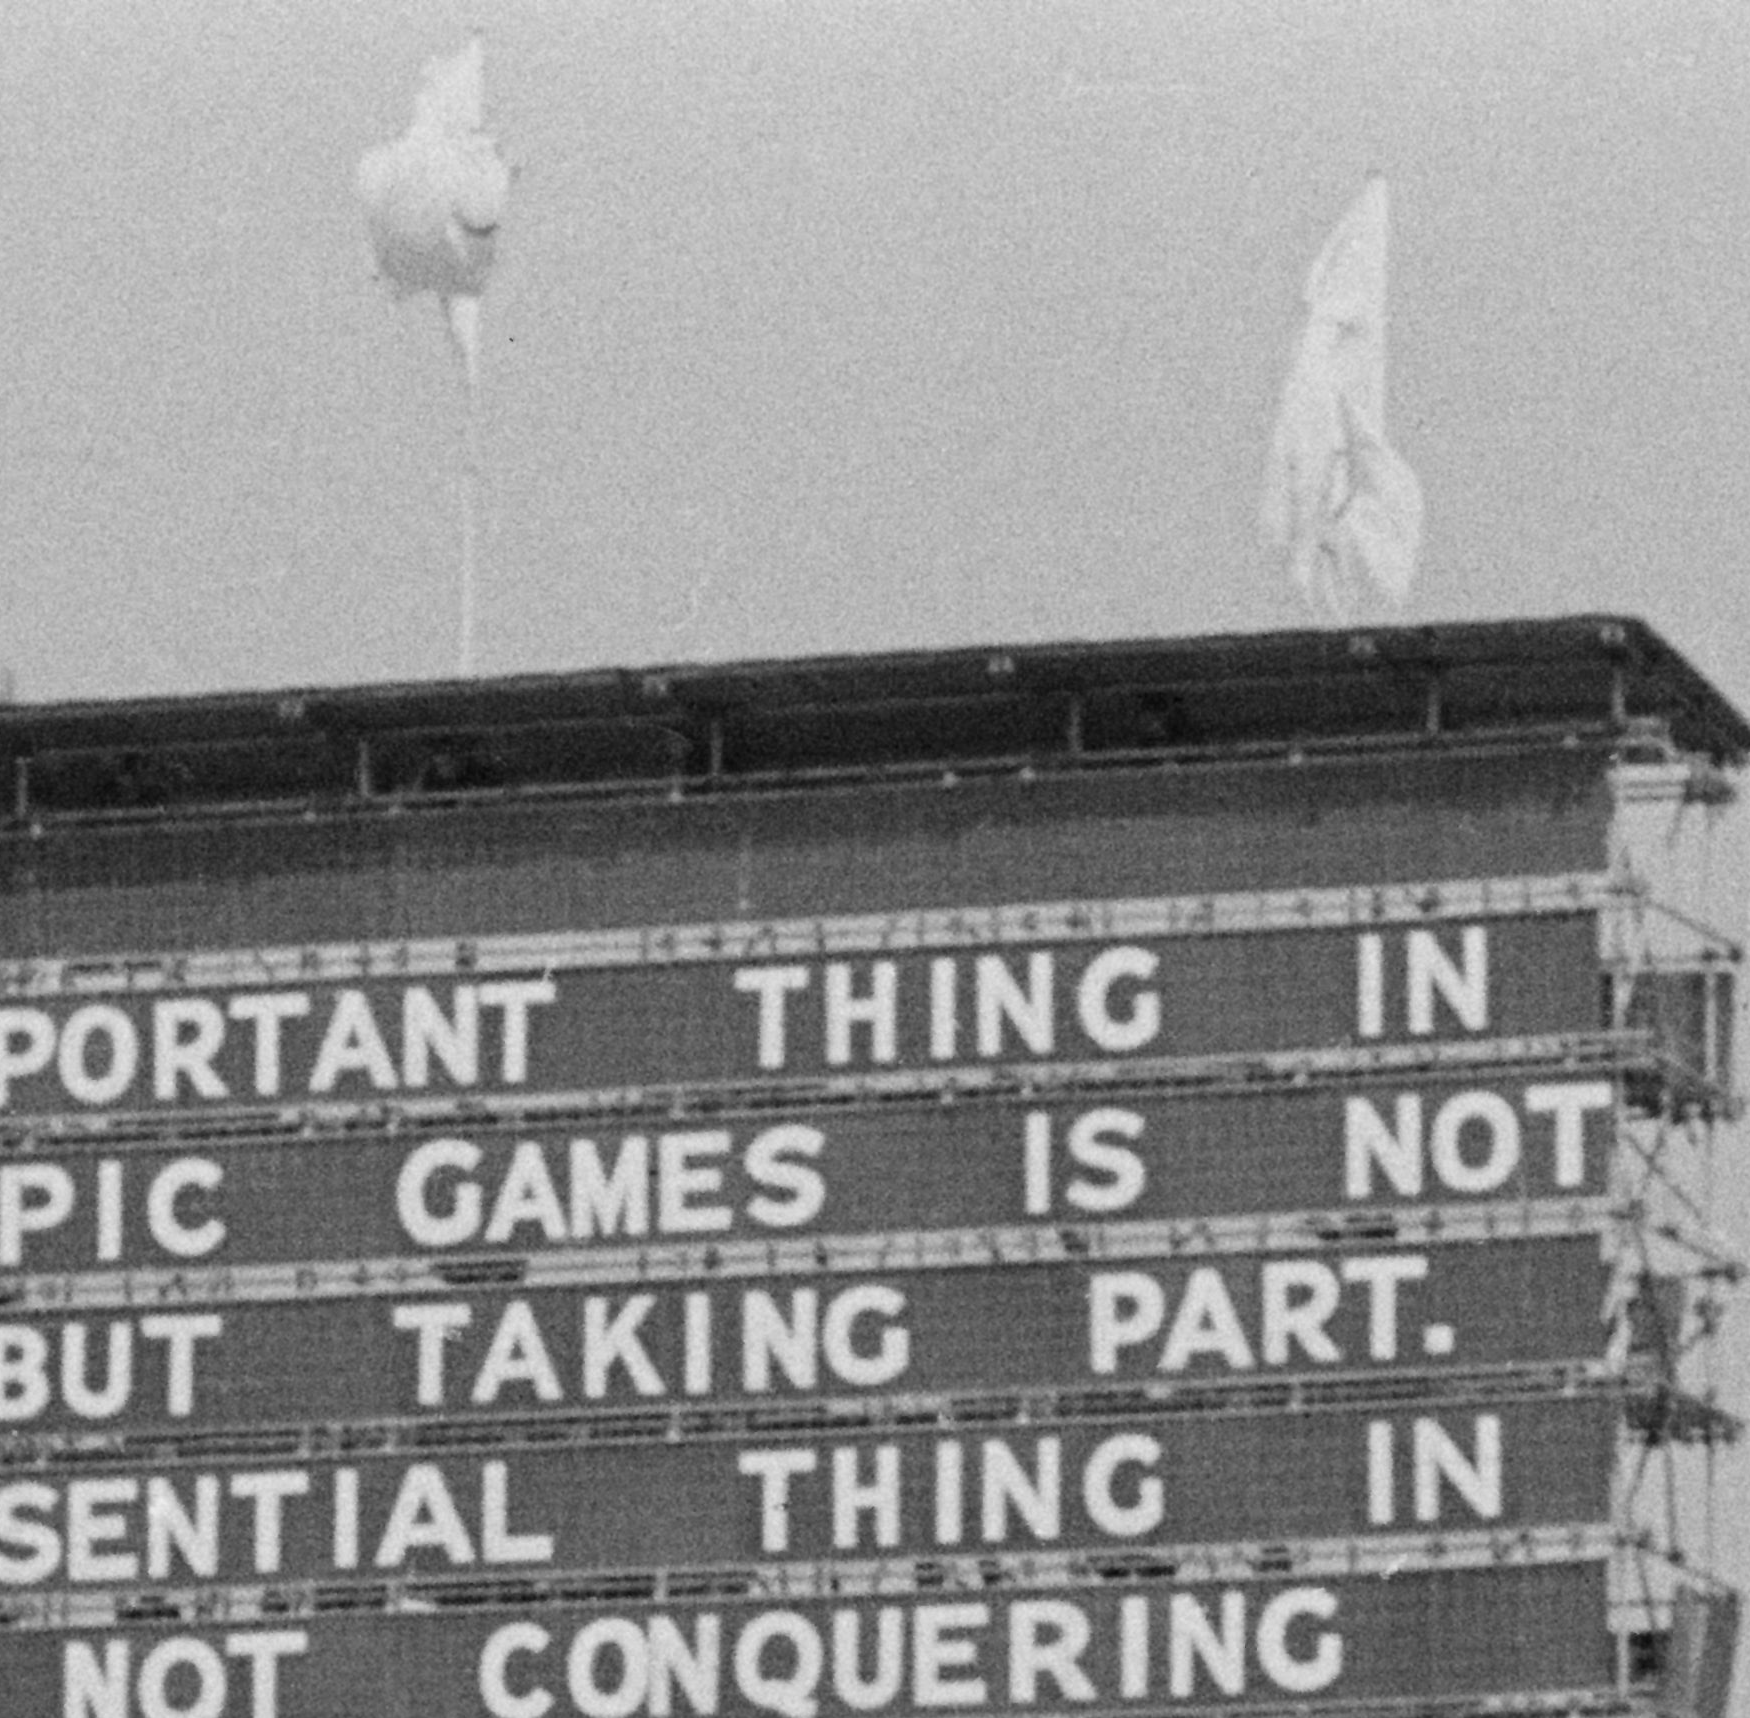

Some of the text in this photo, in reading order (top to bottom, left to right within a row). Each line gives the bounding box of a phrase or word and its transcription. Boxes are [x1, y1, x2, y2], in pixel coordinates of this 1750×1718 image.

[734, 946, 1162, 1069] THING
[1357, 926, 1489, 1038] IN
[396, 1124, 826, 1247] GAMES
[1024, 1107, 1146, 1214] IS
[1343, 1081, 1617, 1200] NOT
[392, 1284, 910, 1406] TAKING
[1085, 1255, 1455, 1375] PART.
[737, 1433, 1165, 1552] THING
[1367, 1414, 1503, 1525] IN
